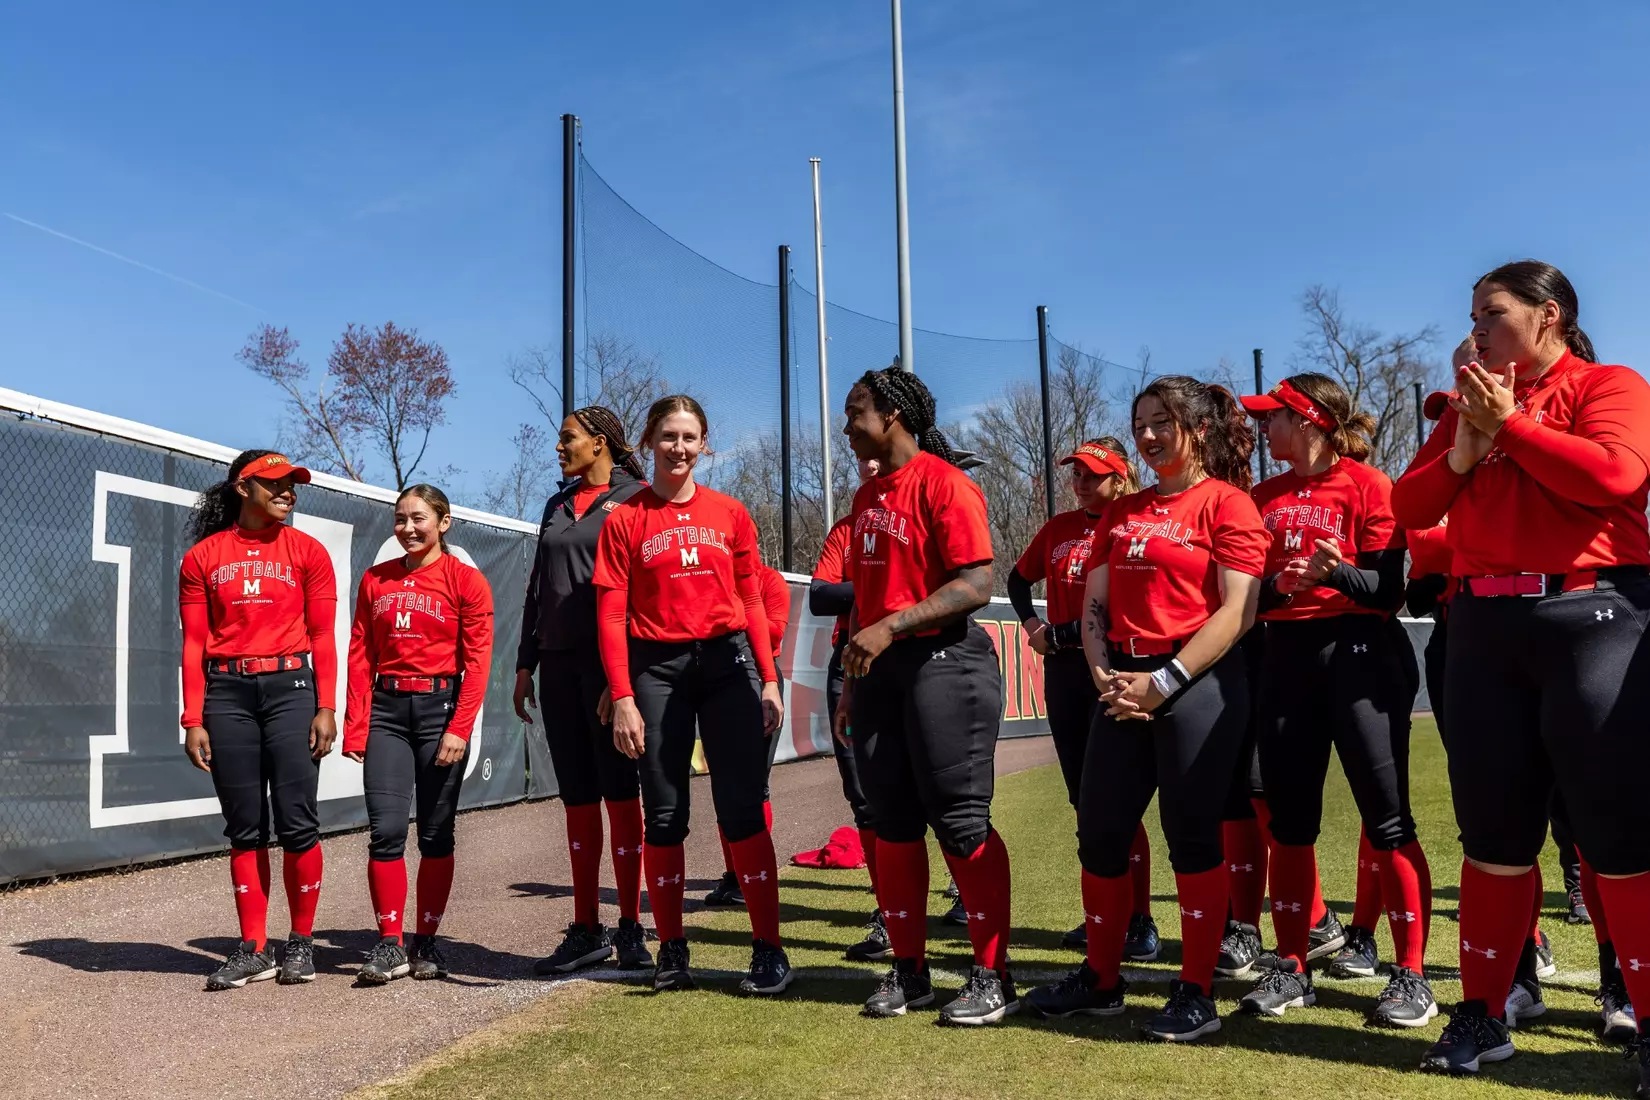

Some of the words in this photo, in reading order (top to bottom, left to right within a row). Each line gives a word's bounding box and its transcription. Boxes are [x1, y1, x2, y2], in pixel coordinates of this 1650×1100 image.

[1264, 505, 1347, 542] OFTBALL
[641, 526, 730, 562] SOFTBALL
[863, 533, 877, 554] M
[1126, 537, 1150, 558] M
[1284, 529, 1304, 551] M
[680, 547, 700, 567] M
[242, 579, 261, 595] M
[395, 611, 412, 629] M
